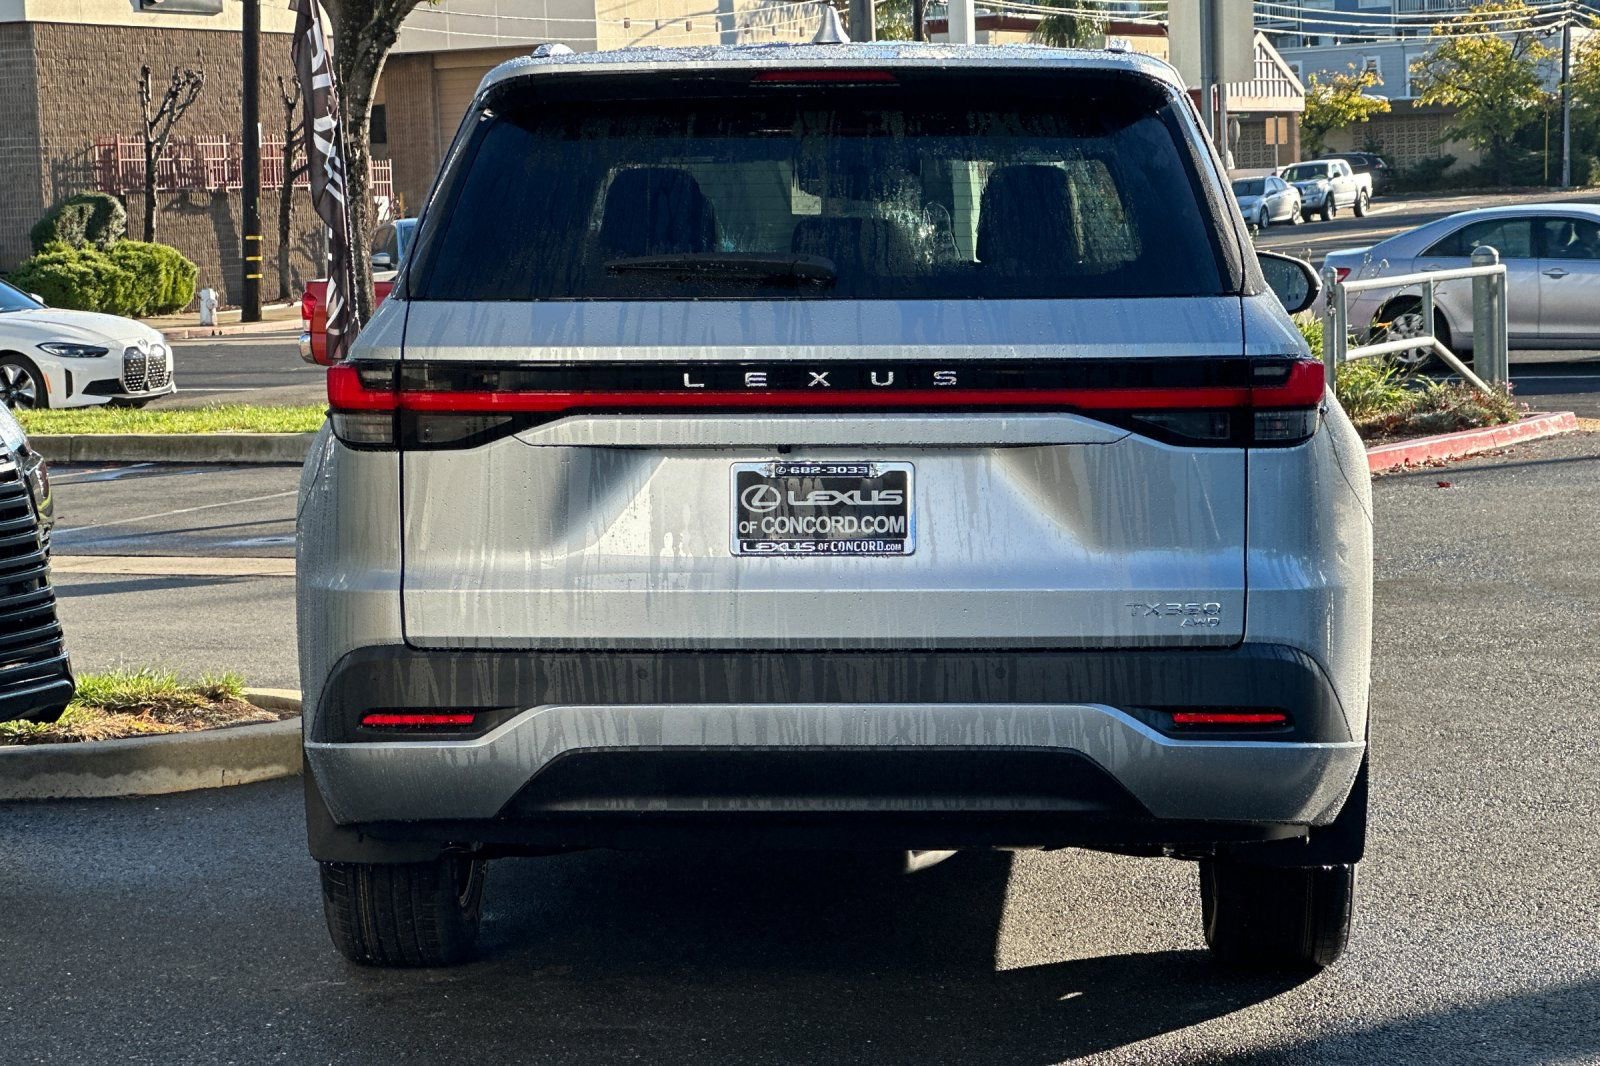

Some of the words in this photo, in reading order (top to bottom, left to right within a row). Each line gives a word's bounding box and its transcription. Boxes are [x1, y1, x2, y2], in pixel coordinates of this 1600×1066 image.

[683, 371, 957, 388] LEXUS
[787, 490, 903, 506] LEXUS
[739, 521, 757, 533] OF
[761, 515, 905, 533] CONCORD.COM
[742, 542, 815, 552] LEXUS
[818, 543, 830, 551] OF
[1180, 618, 1220, 628] AWD
